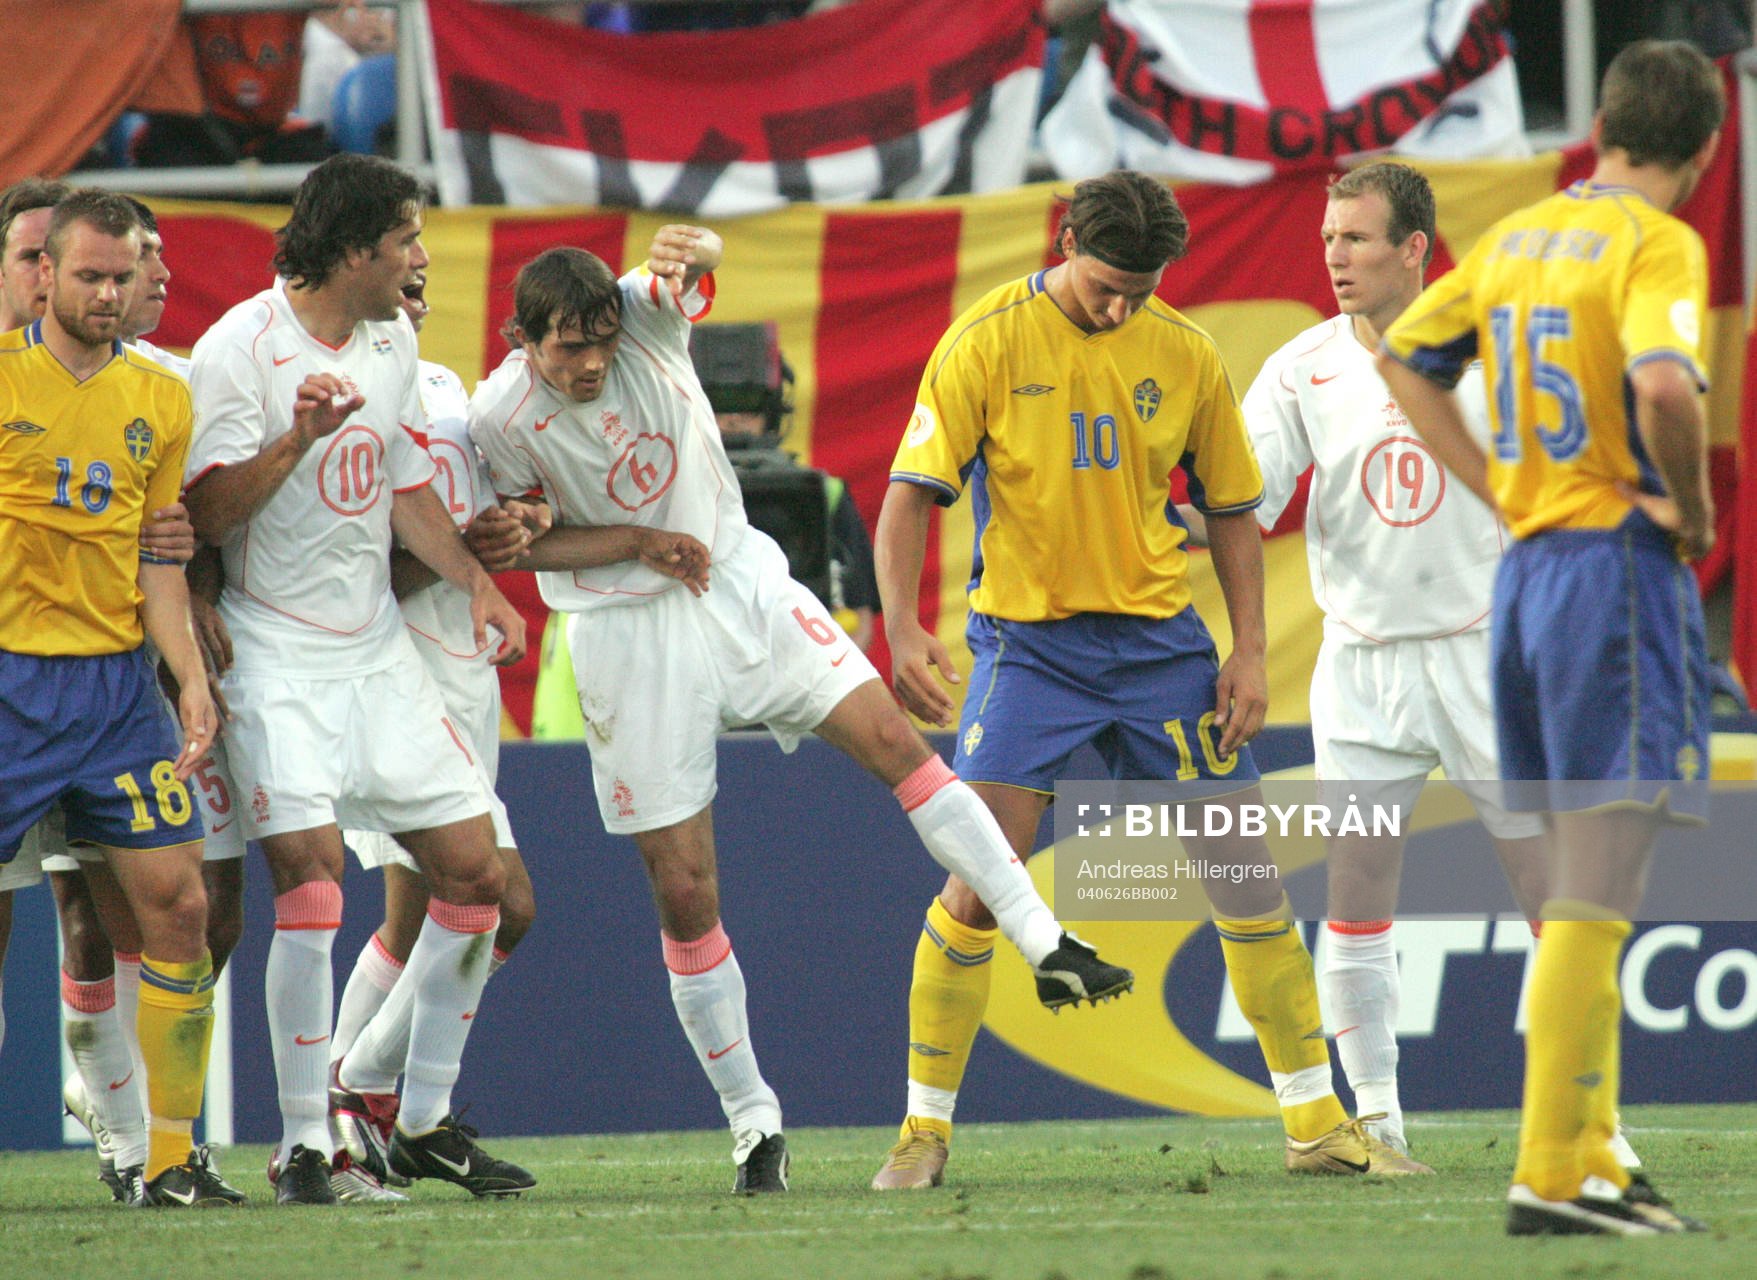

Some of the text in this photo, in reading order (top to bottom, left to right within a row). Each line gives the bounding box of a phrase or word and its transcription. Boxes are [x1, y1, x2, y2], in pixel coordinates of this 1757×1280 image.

[1489, 306, 1589, 463] 15
[1071, 411, 1119, 470] 10
[52, 457, 113, 515] 18
[338, 442, 375, 503] 10
[1384, 452, 1422, 510] 19
[791, 606, 837, 647] 6
[1163, 710, 1238, 782] 10
[114, 760, 192, 832] 18
[195, 757, 230, 814] 5
[1620, 924, 1757, 1033] Co
